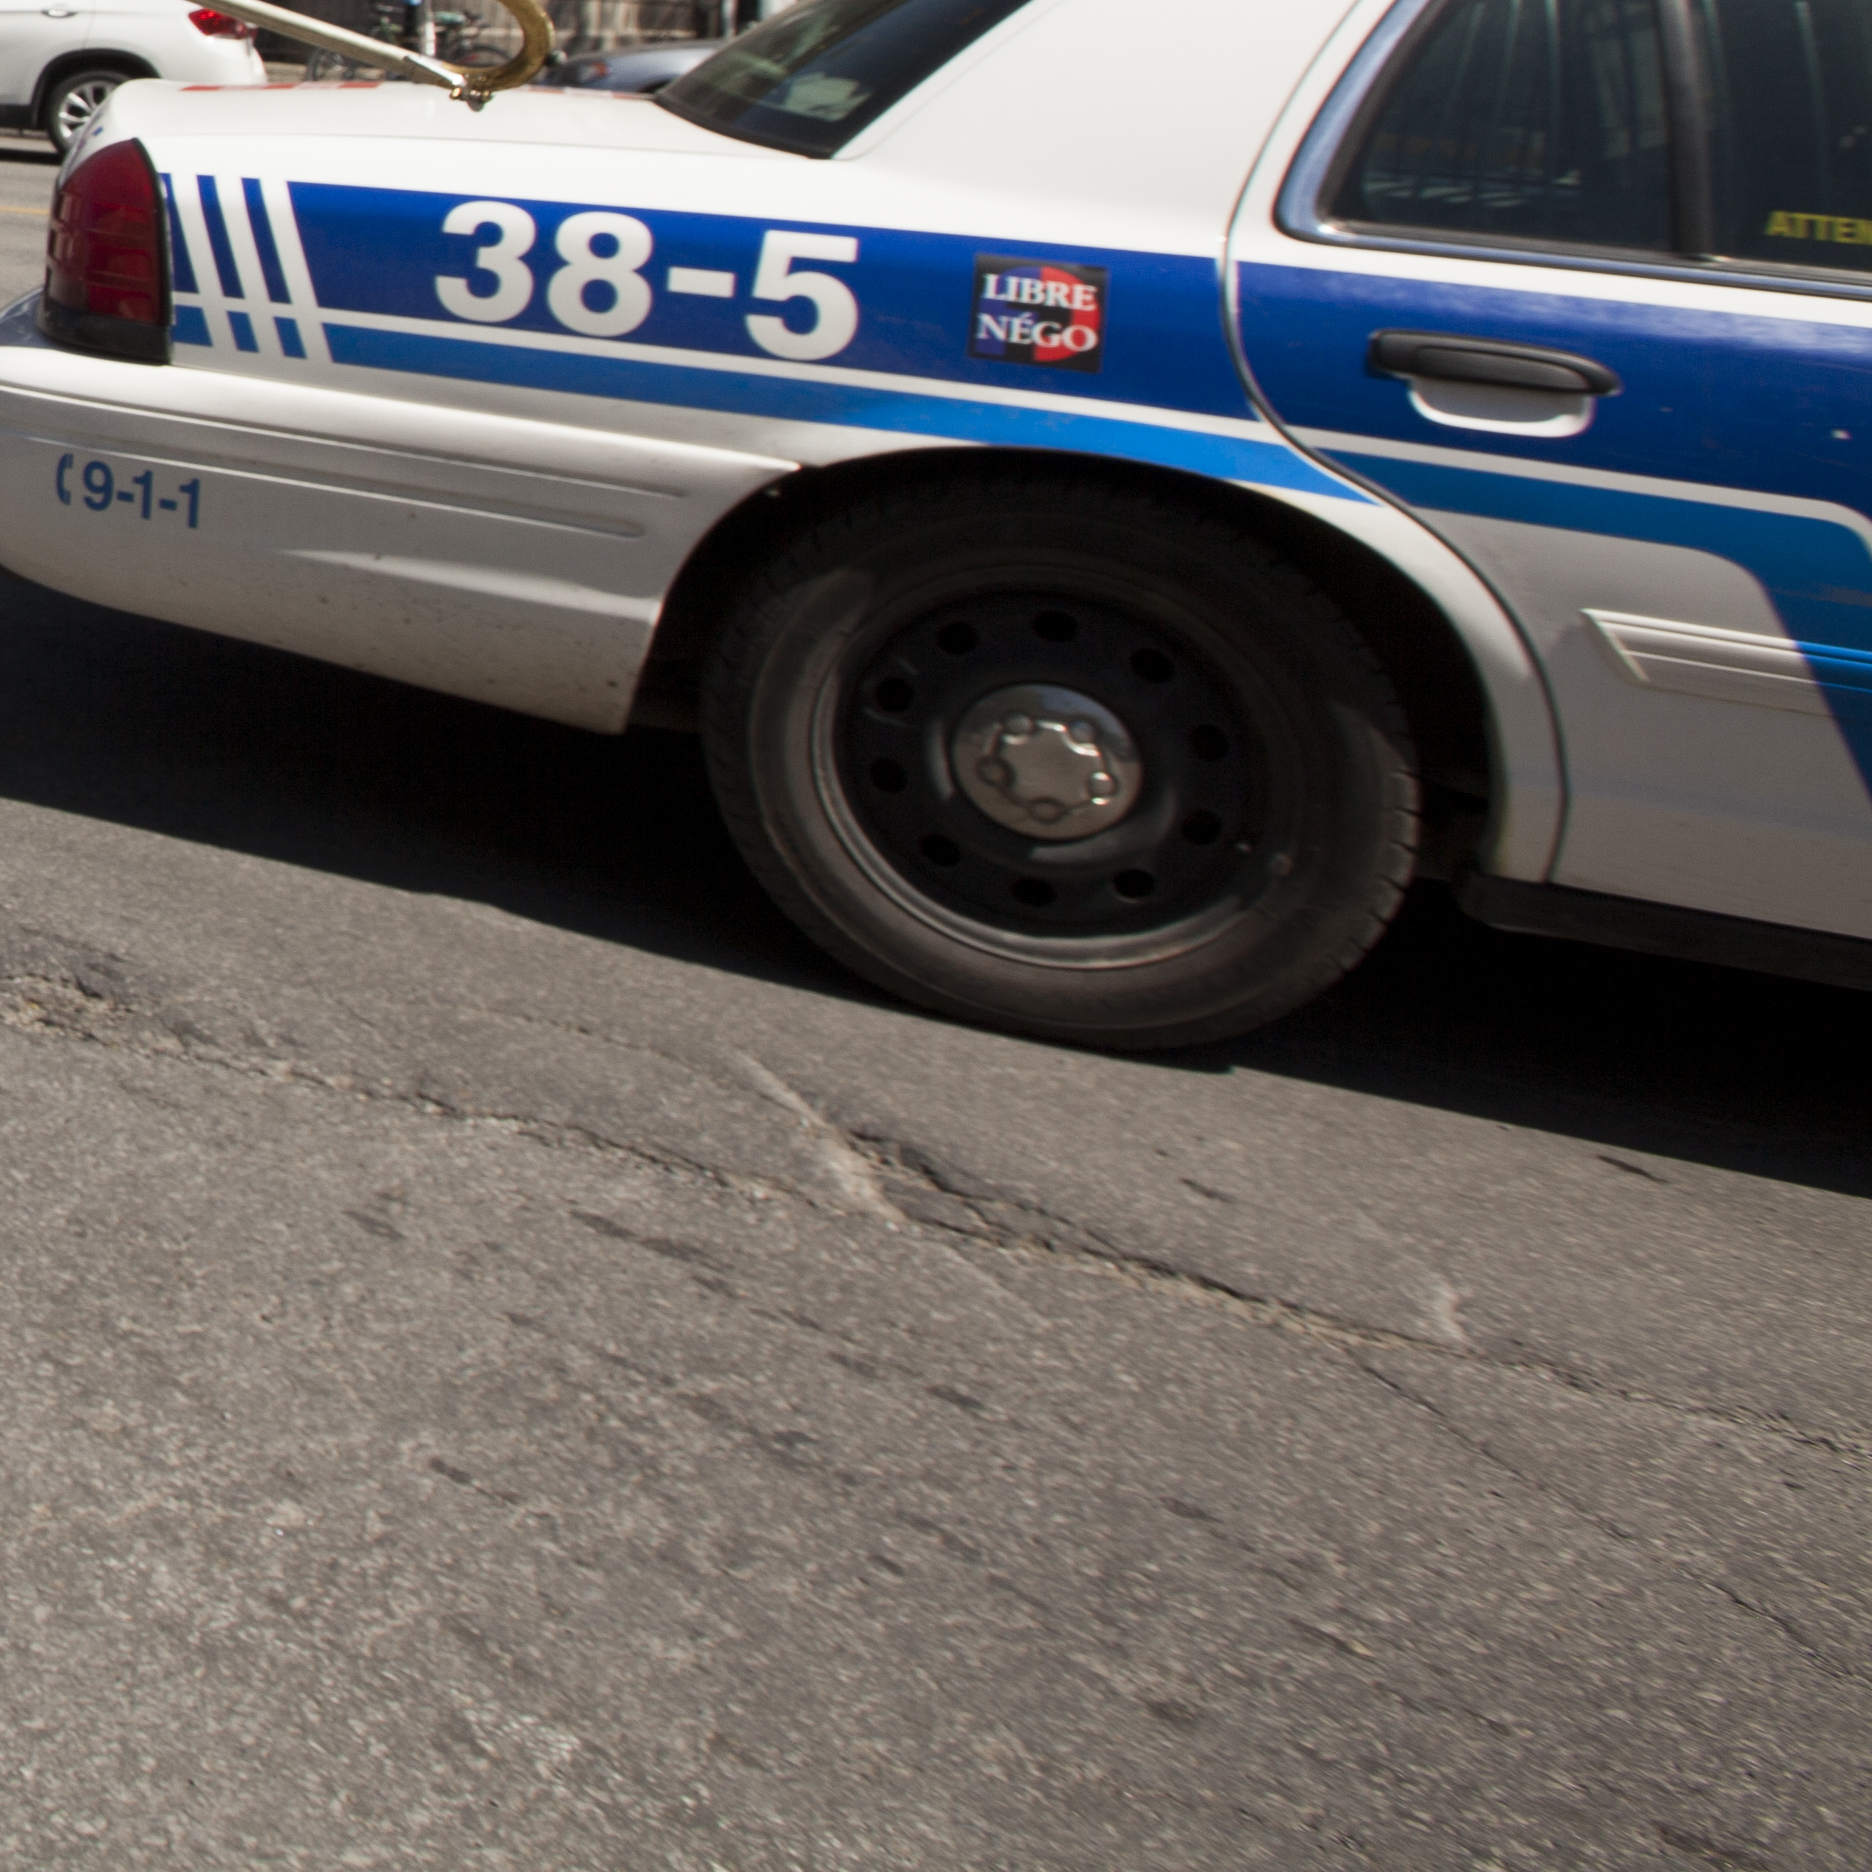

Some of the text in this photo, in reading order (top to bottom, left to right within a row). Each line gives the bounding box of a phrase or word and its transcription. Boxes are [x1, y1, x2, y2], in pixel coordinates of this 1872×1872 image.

[434, 200, 858, 361] 38-5
[983, 272, 1098, 312] LIBRE
[975, 309, 1098, 354] NÉGO
[83, 460, 200, 529] 9-1-1
